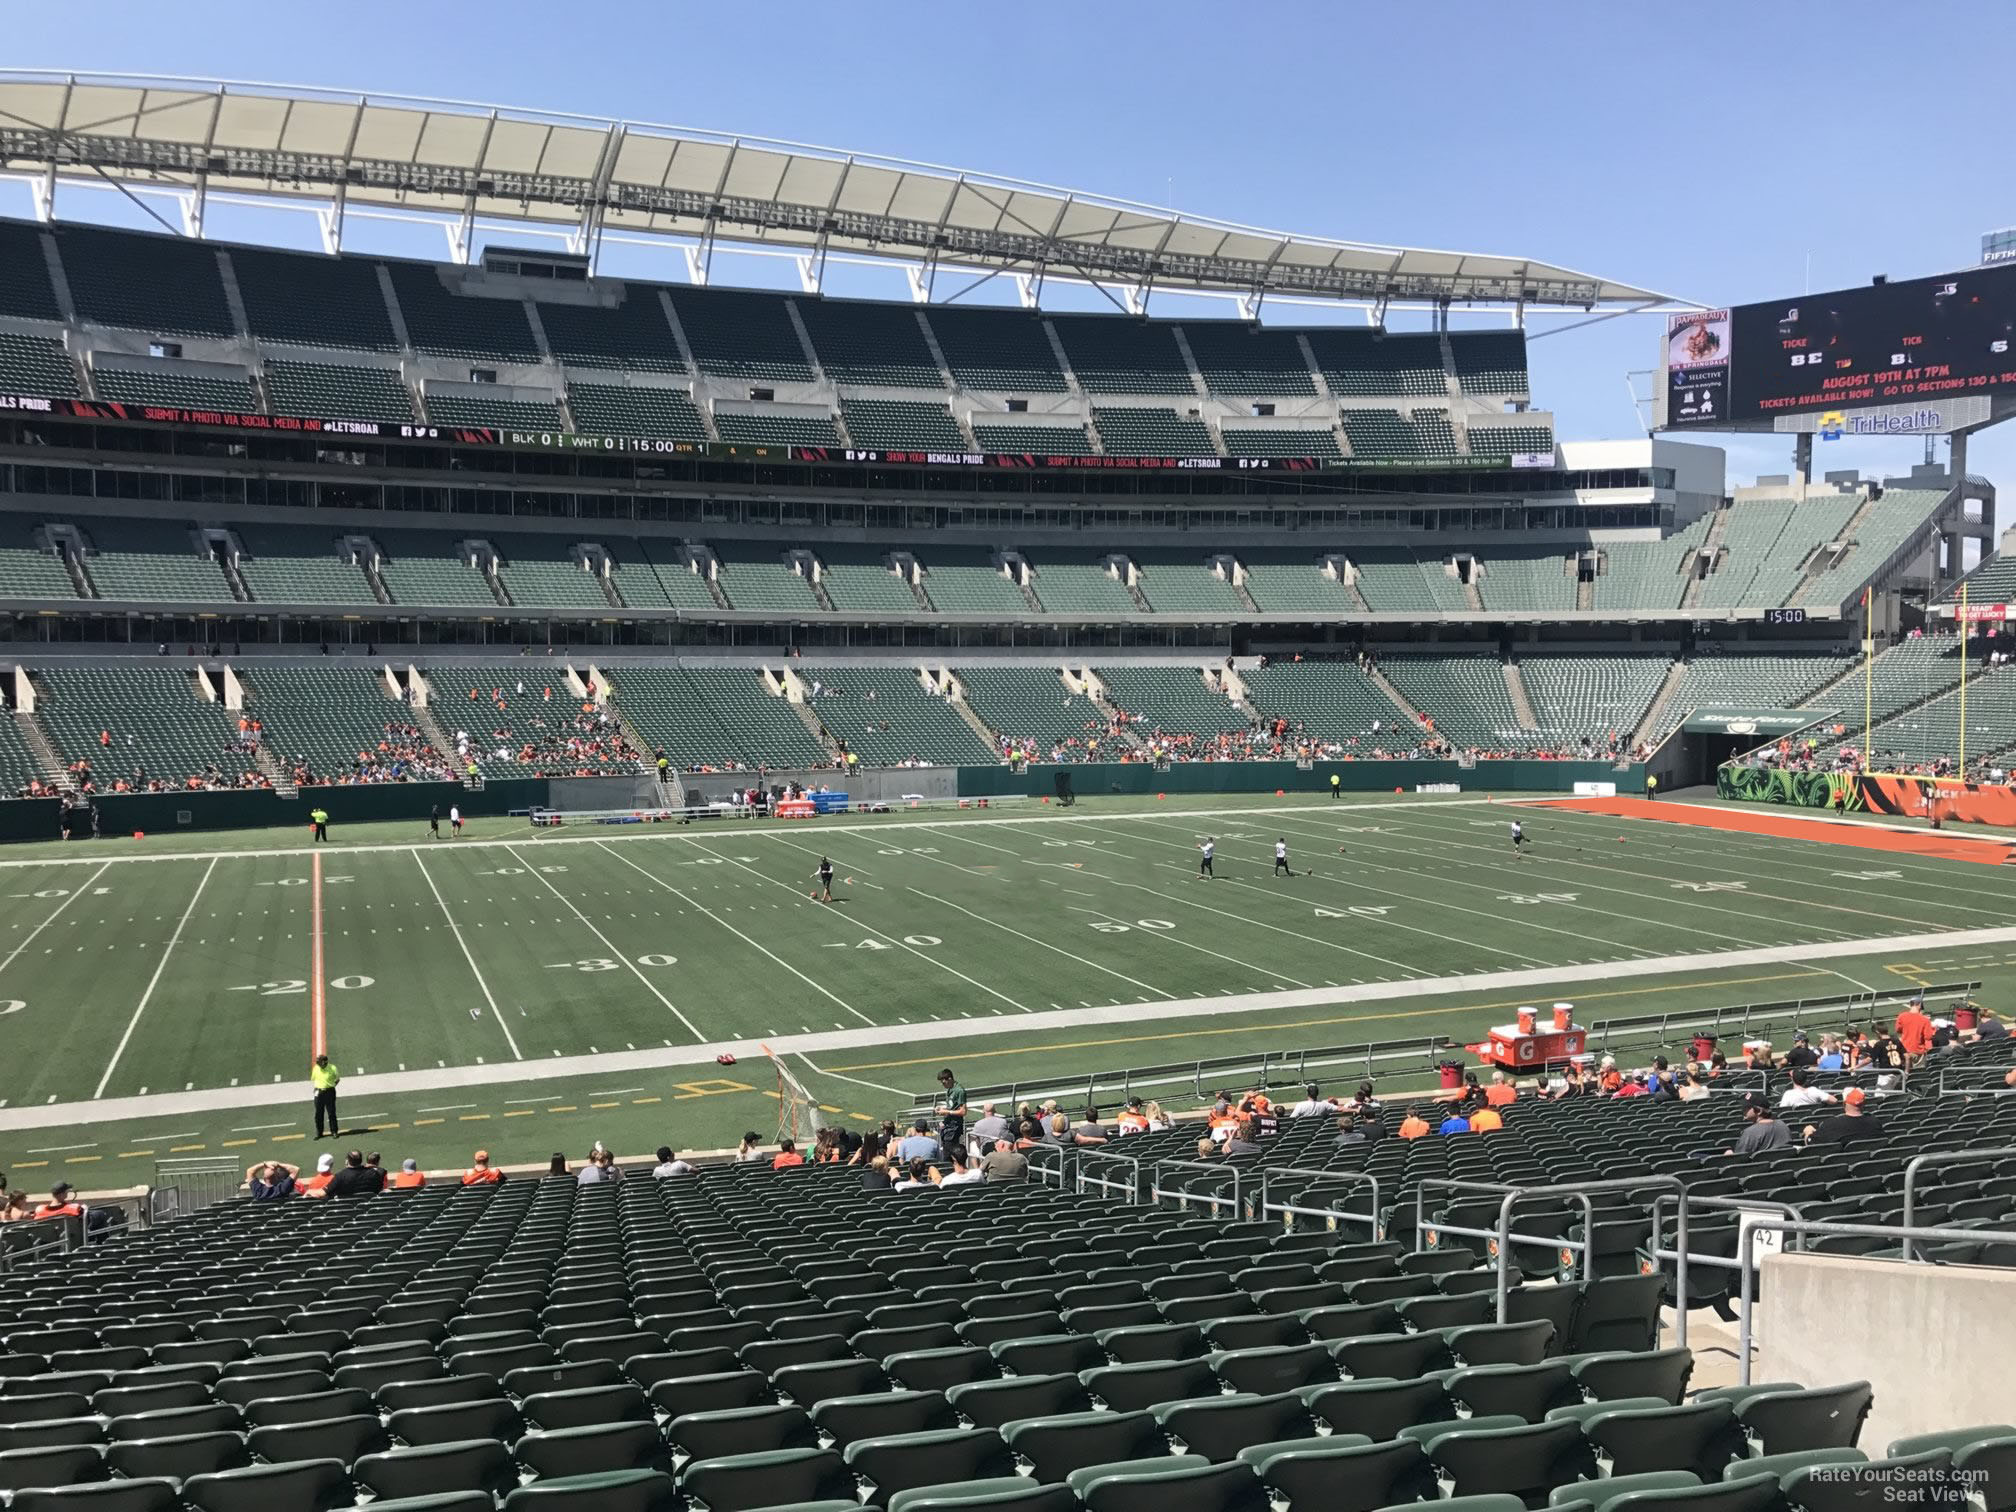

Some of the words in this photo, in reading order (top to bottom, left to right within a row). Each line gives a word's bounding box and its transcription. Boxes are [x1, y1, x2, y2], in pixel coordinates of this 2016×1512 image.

[1984, 250, 2016, 262] FIFTH
[1689, 372, 1721, 381] SELECTIVE
[1823, 374, 1869, 389] AUGUST
[1874, 372, 1901, 383] 19TH
[1906, 369, 1920, 380] AT
[1925, 365, 1949, 377] 7PM
[1760, 396, 1795, 409] TICKETS
[1799, 391, 1845, 405] AVAILABLE
[1849, 388, 1874, 399] NOW!
[1884, 386, 1898, 396] GO
[1902, 383, 1914, 393] TO
[1917, 377, 1965, 392] SECTIONS
[1968, 375, 1986, 386] 130
[1990, 375, 1997, 383] &
[19, 399, 51, 412] PRIDE
[145, 407, 179, 421] SUBMIT
[183, 410, 190, 422] A
[193, 411, 221, 424] PHOTO
[224, 414, 238, 425] VIA
[242, 415, 271, 428] SOCIAL
[273, 418, 300, 429] MEDIA
[304, 420, 320, 431] AND
[324, 421, 378, 435] #LETSROAR
[1851, 409, 1940, 434] TriHealth
[512, 433, 535, 444] BLK
[541, 434, 550, 446] 0
[572, 437, 599, 448] WHT
[604, 437, 613, 449] 0
[632, 440, 674, 453] 15:00
[676, 444, 692, 452] QTR
[697, 444, 703, 453] 1
[886, 453, 906, 462] SHOW
[908, 453, 925, 463] YOUR
[927, 453, 961, 464] BENGALS
[963, 454, 984, 464] PRIDE
[1048, 456, 1072, 466] SUBMIT
[1080, 457, 1101, 467] PHOTO
[1103, 458, 1114, 467] VIA
[1116, 458, 1138, 468] SOCIAL
[1140, 459, 1160, 468] MEDIA
[1163, 459, 1176, 468] AND
[1178, 459, 1221, 468] #LETSROAR
[1769, 610, 1803, 624] 15:00
[1088, 919, 1176, 933] 50
[856, 935, 943, 950] 40
[575, 954, 678, 972] 30
[260, 974, 376, 996] 20
[1520, 1040, 1534, 1060] G
[1887, 1050, 1902, 1066] 18
[1756, 1229, 1774, 1246] 42
